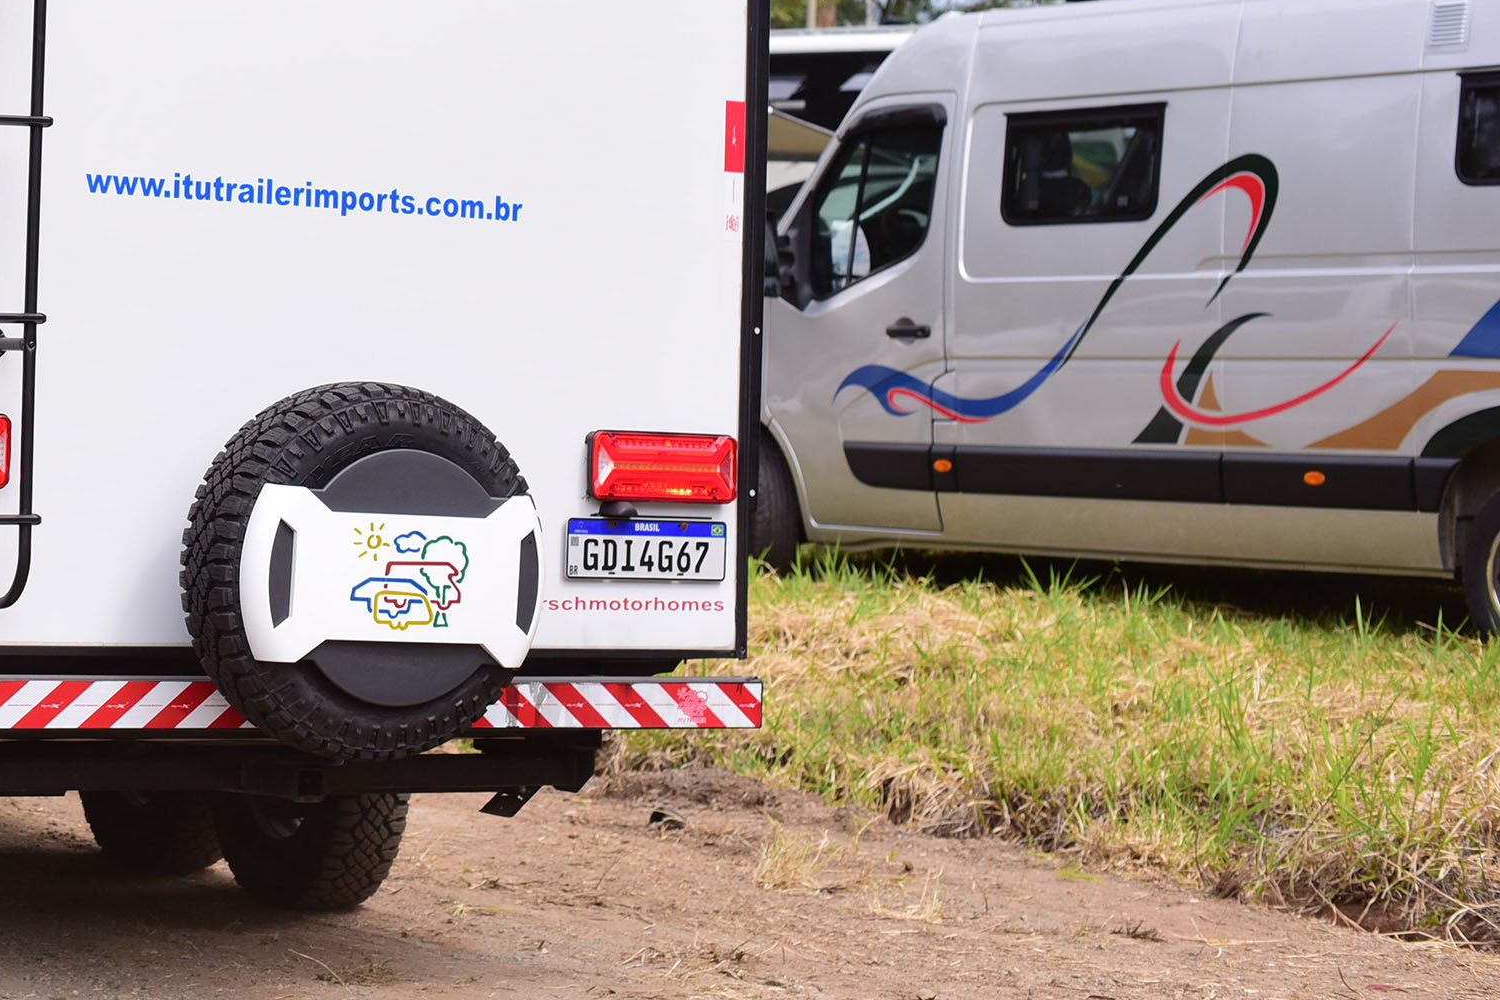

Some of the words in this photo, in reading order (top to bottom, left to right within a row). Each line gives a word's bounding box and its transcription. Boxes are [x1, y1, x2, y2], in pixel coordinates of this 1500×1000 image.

[86, 173, 523, 222] www.itutrailerimports.com.br
[634, 522, 660, 532] BRASIL
[583, 538, 709, 574] GDI4G67
[569, 565, 579, 575] BR
